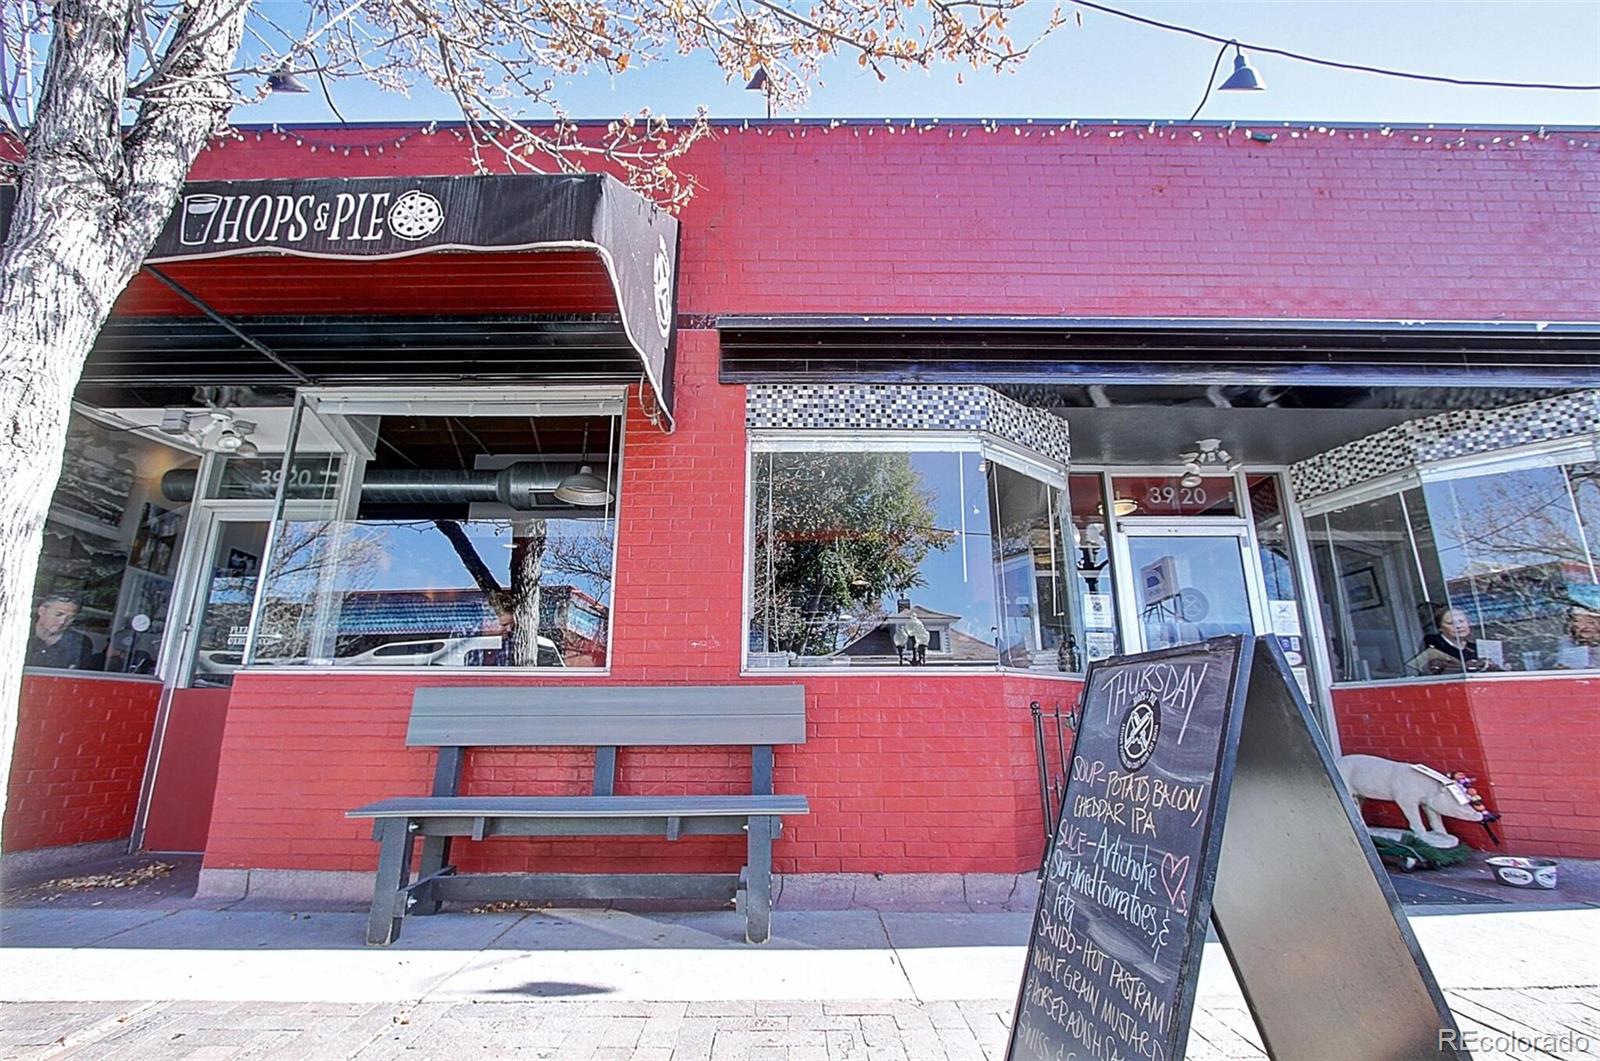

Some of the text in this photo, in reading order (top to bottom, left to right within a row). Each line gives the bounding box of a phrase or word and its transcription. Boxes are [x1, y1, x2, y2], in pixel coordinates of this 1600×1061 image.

[1150, 486, 1207, 504] 3920
[1101, 662, 1209, 745] THURSDAY
[1073, 794, 1157, 839] CHEDDAR IPA
[1093, 826, 1158, 896] Artichoke
[1082, 938, 1111, 976] HOT
[1017, 1011, 1050, 1060] SWISS
[1063, 964, 1101, 1016] GRAIN
[1101, 997, 1165, 1061] MUSTARD
